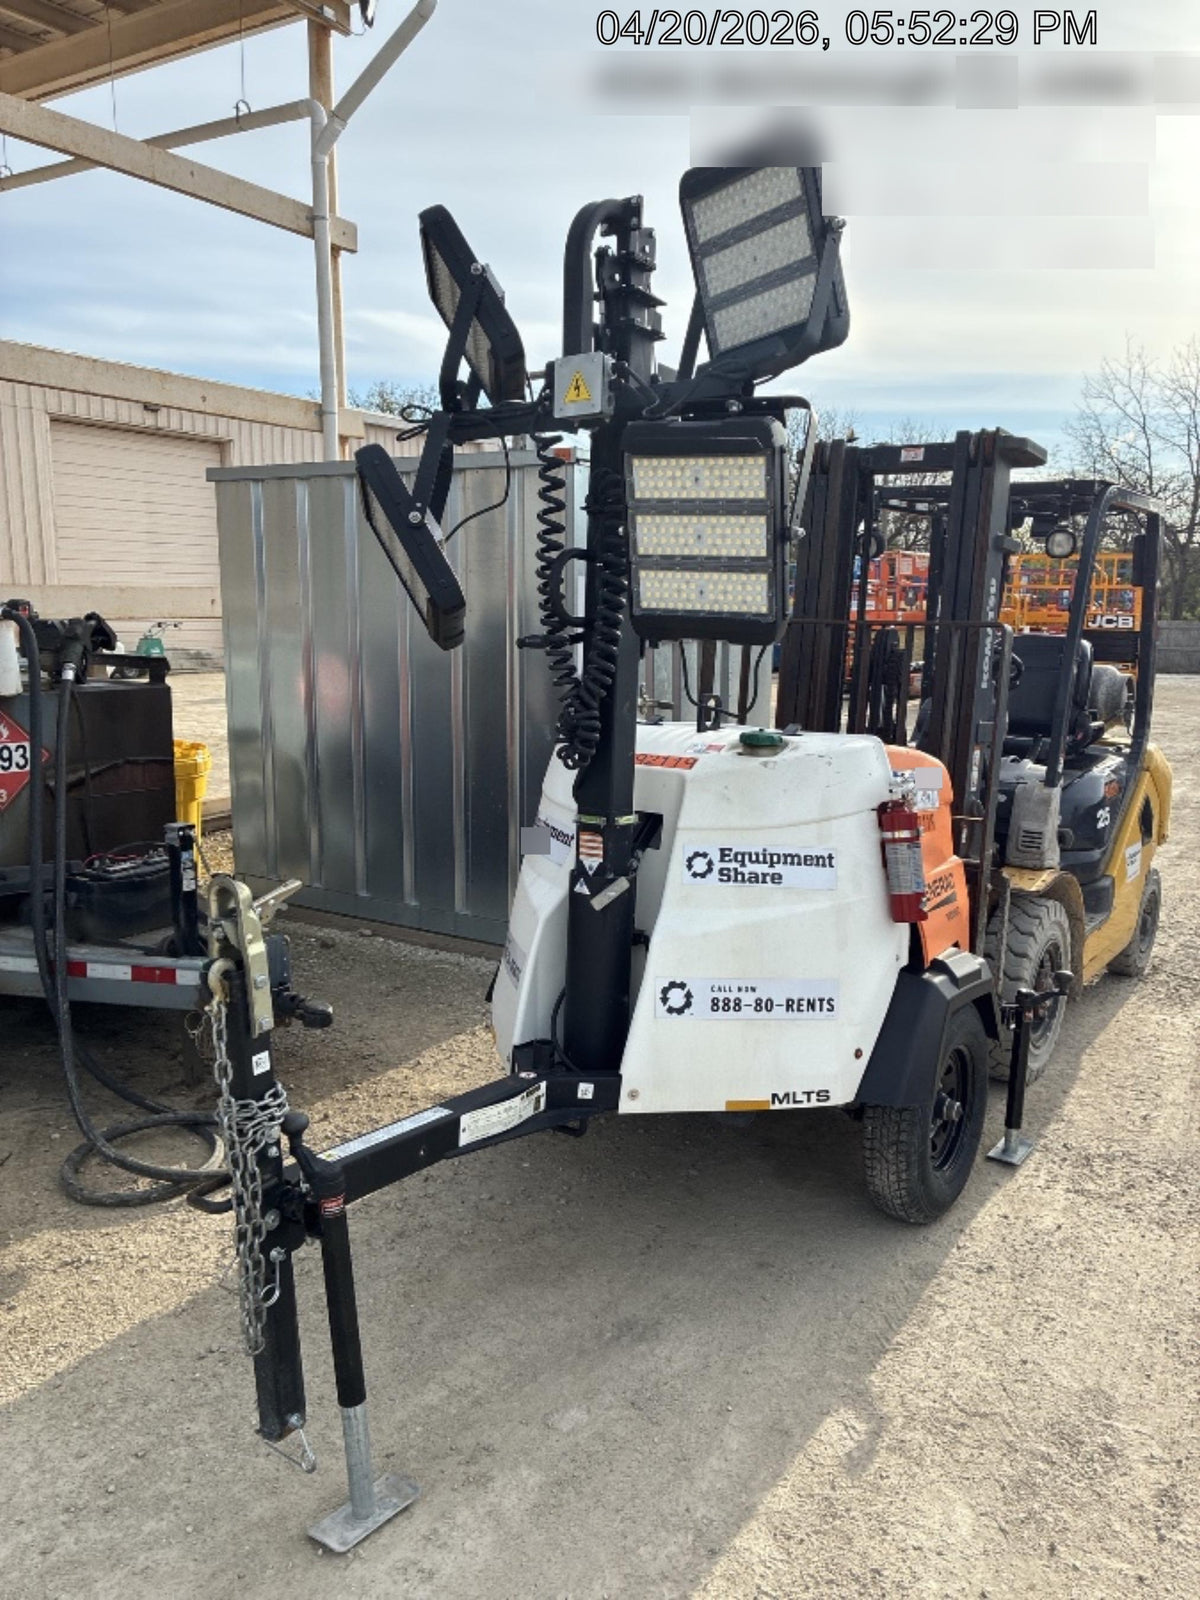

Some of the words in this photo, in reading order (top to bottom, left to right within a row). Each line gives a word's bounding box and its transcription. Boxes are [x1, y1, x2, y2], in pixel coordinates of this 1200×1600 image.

[1088, 615, 1134, 628] JCB
[1096, 806, 1110, 829] 25
[718, 847, 835, 868] Equipment
[718, 867, 783, 885] Share
[710, 984, 733, 993] CALL
[737, 985, 758, 993] NOW
[710, 996, 836, 1013] 888-80-RENTS
[771, 1089, 830, 1105] MLTS
